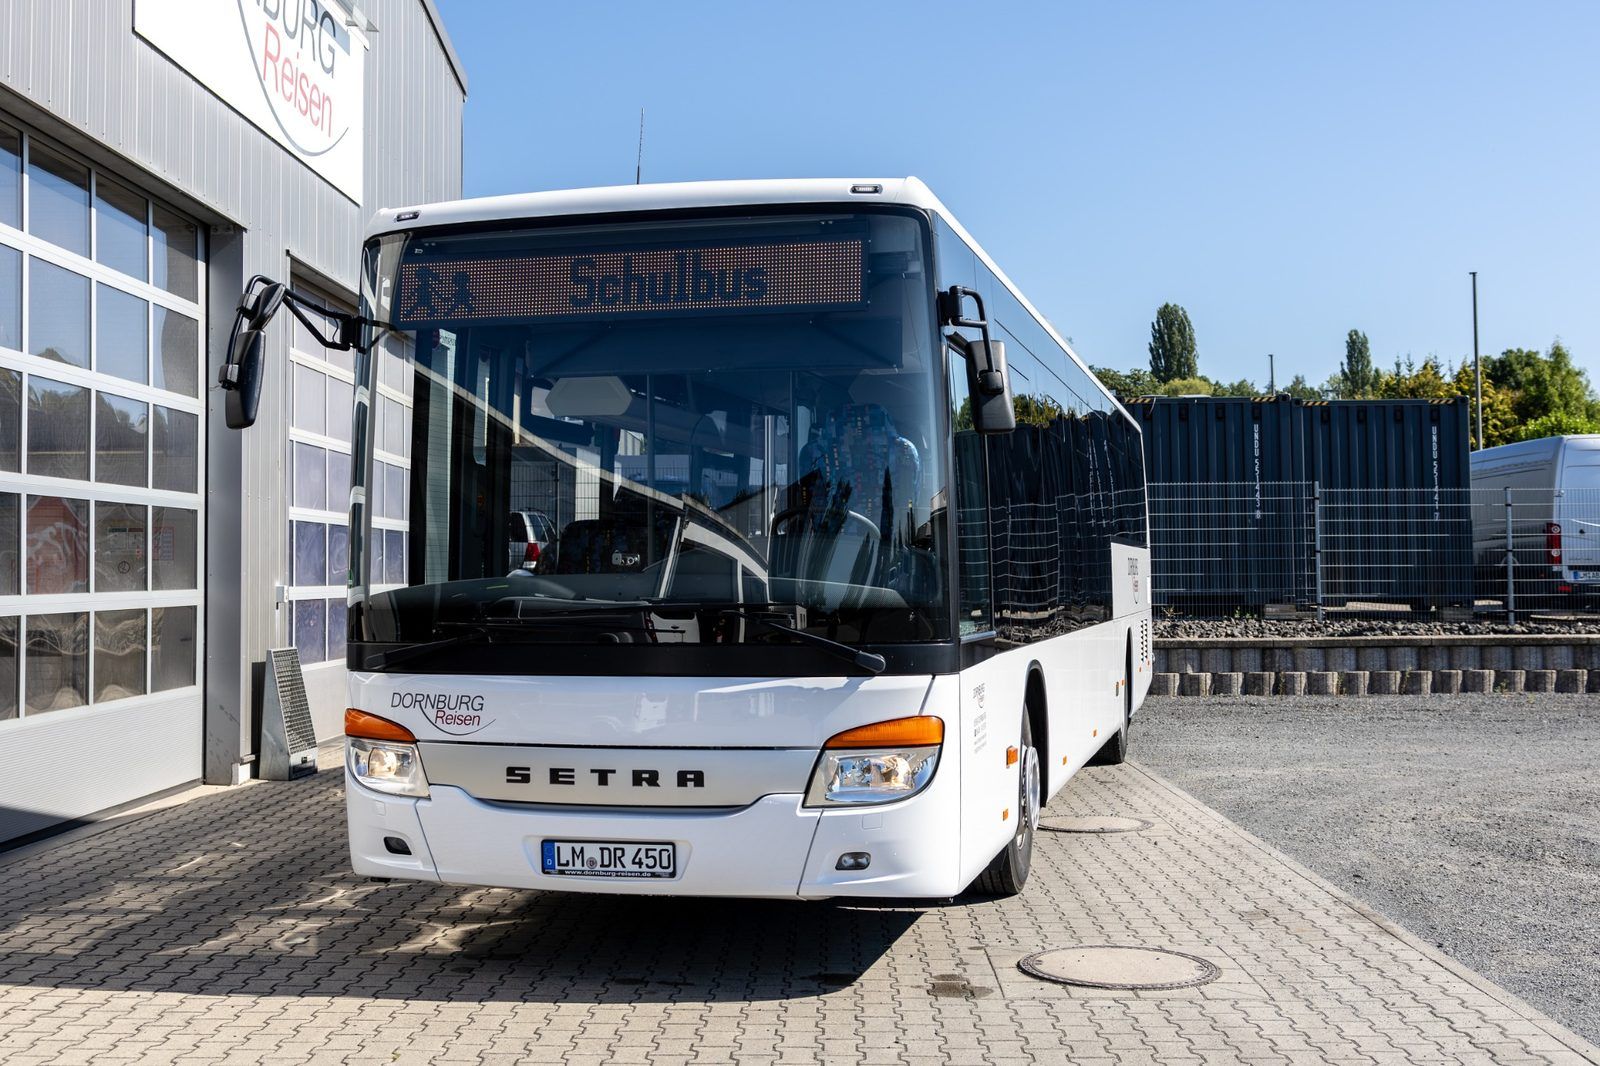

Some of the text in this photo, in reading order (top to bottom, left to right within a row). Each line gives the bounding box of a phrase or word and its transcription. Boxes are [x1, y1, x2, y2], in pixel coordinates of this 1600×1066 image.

[257, 0, 336, 79] URG
[263, 22, 332, 137] Reisen
[569, 251, 768, 308] Schulbus
[391, 692, 485, 711] DORNBURG
[434, 710, 481, 726] Reisen
[506, 766, 705, 788] SETRA
[556, 846, 585, 868] LM
[599, 847, 626, 868] DR
[631, 848, 672, 870] 450
[564, 869, 652, 877] www.dornburg-reisen.de
